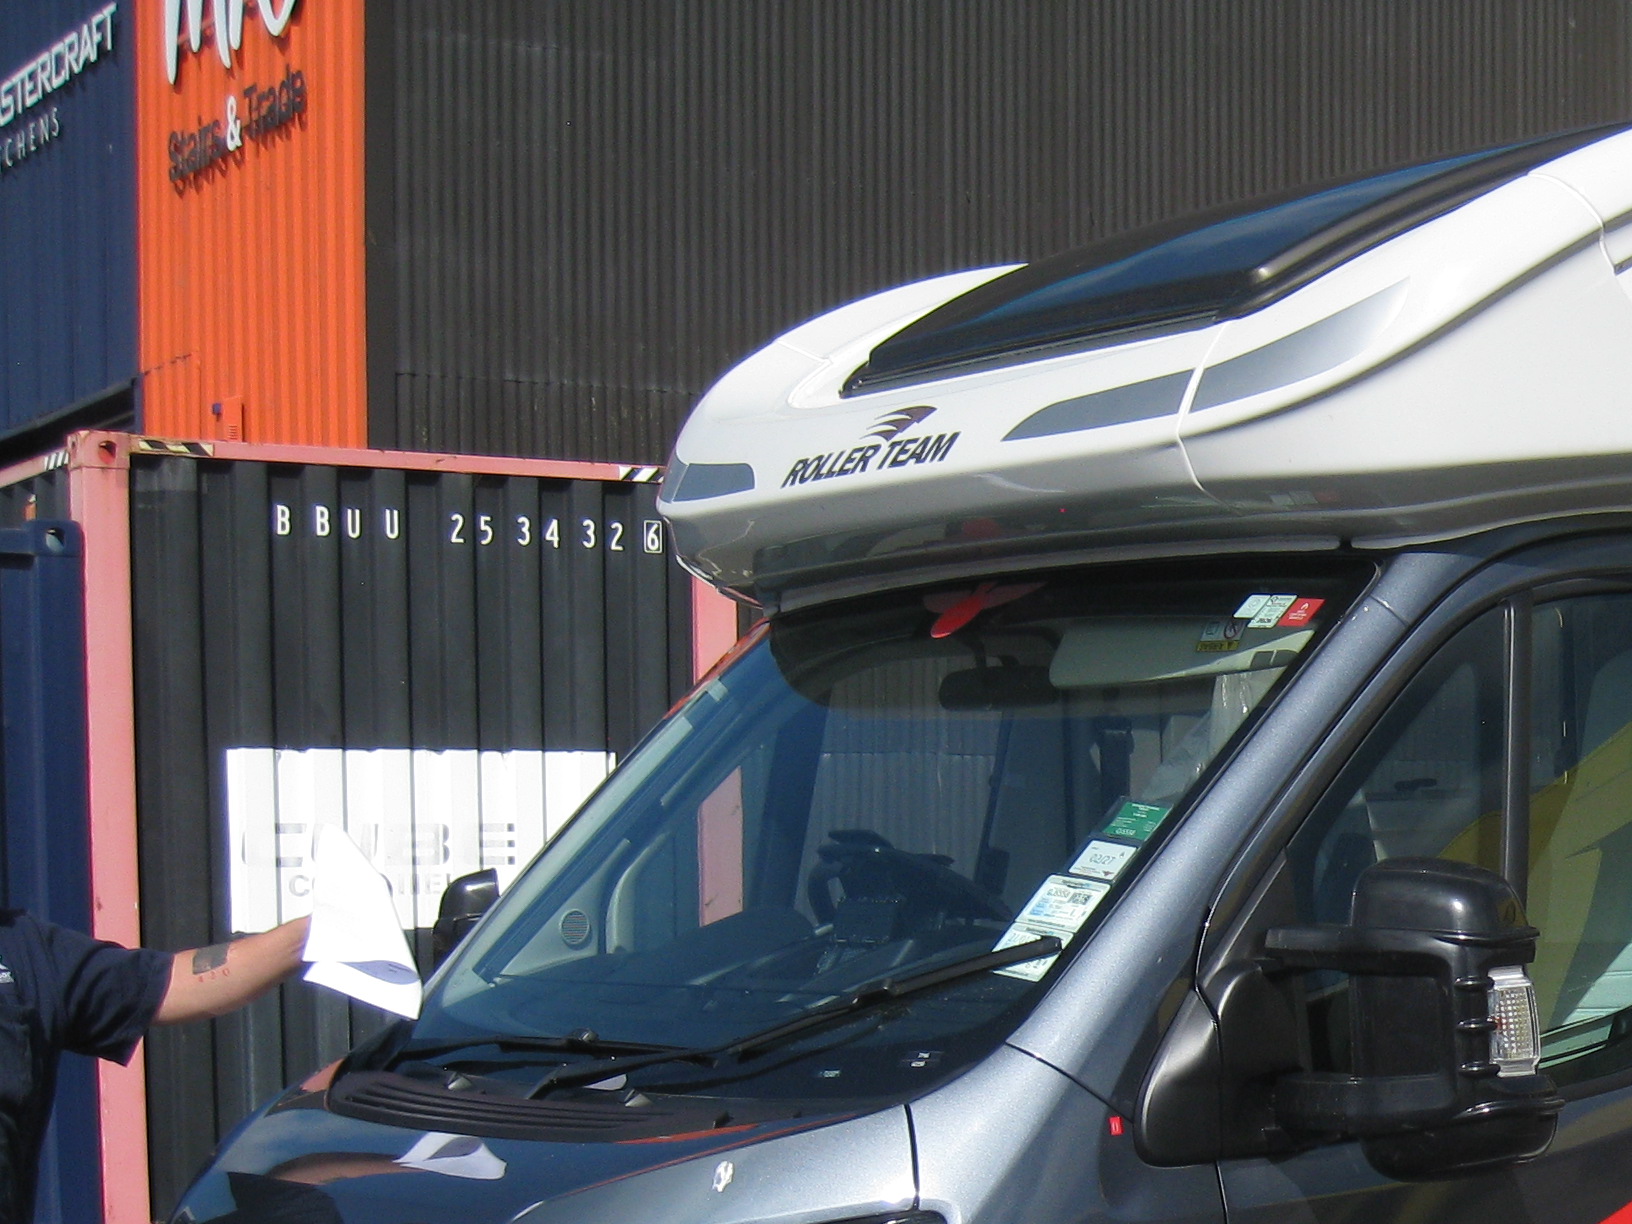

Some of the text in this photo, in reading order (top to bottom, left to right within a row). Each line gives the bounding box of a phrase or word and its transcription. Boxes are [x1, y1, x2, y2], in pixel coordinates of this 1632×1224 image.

[226, 95, 243, 152] &
[243, 64, 308, 140] Trade
[780, 431, 962, 489] ROLLER TEAM
